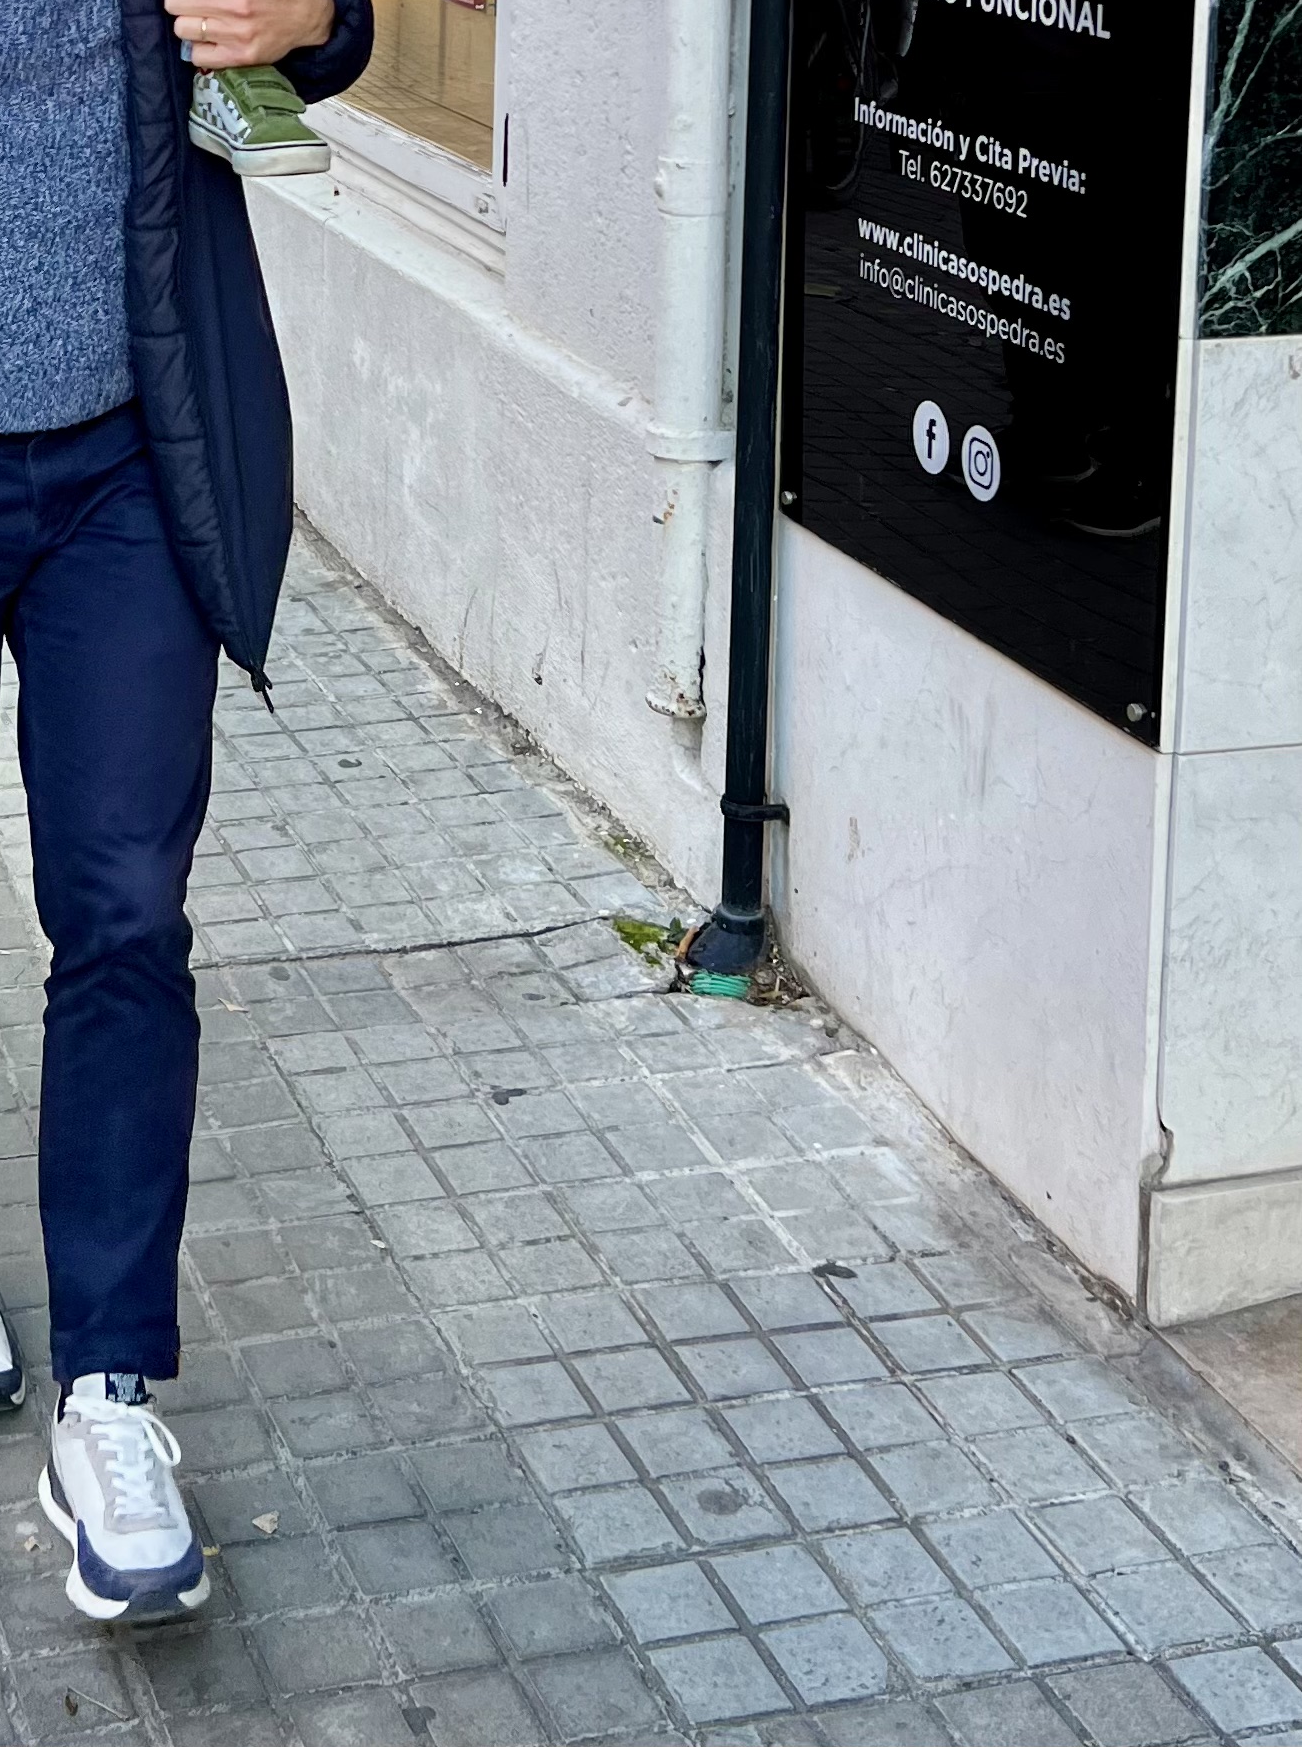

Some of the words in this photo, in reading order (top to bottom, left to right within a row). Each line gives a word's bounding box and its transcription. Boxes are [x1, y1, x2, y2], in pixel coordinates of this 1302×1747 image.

[854, 96, 954, 152] Información
[959, 134, 971, 161] y
[975, 134, 1013, 171] Cita
[1018, 147, 1087, 195] Previa:
[898, 149, 925, 184] Tel.
[930, 160, 1028, 219] 627337692
[857, 217, 1072, 321] www.clinicasospedra.es
[859, 252, 1066, 364] info@clinicasospedra.es
